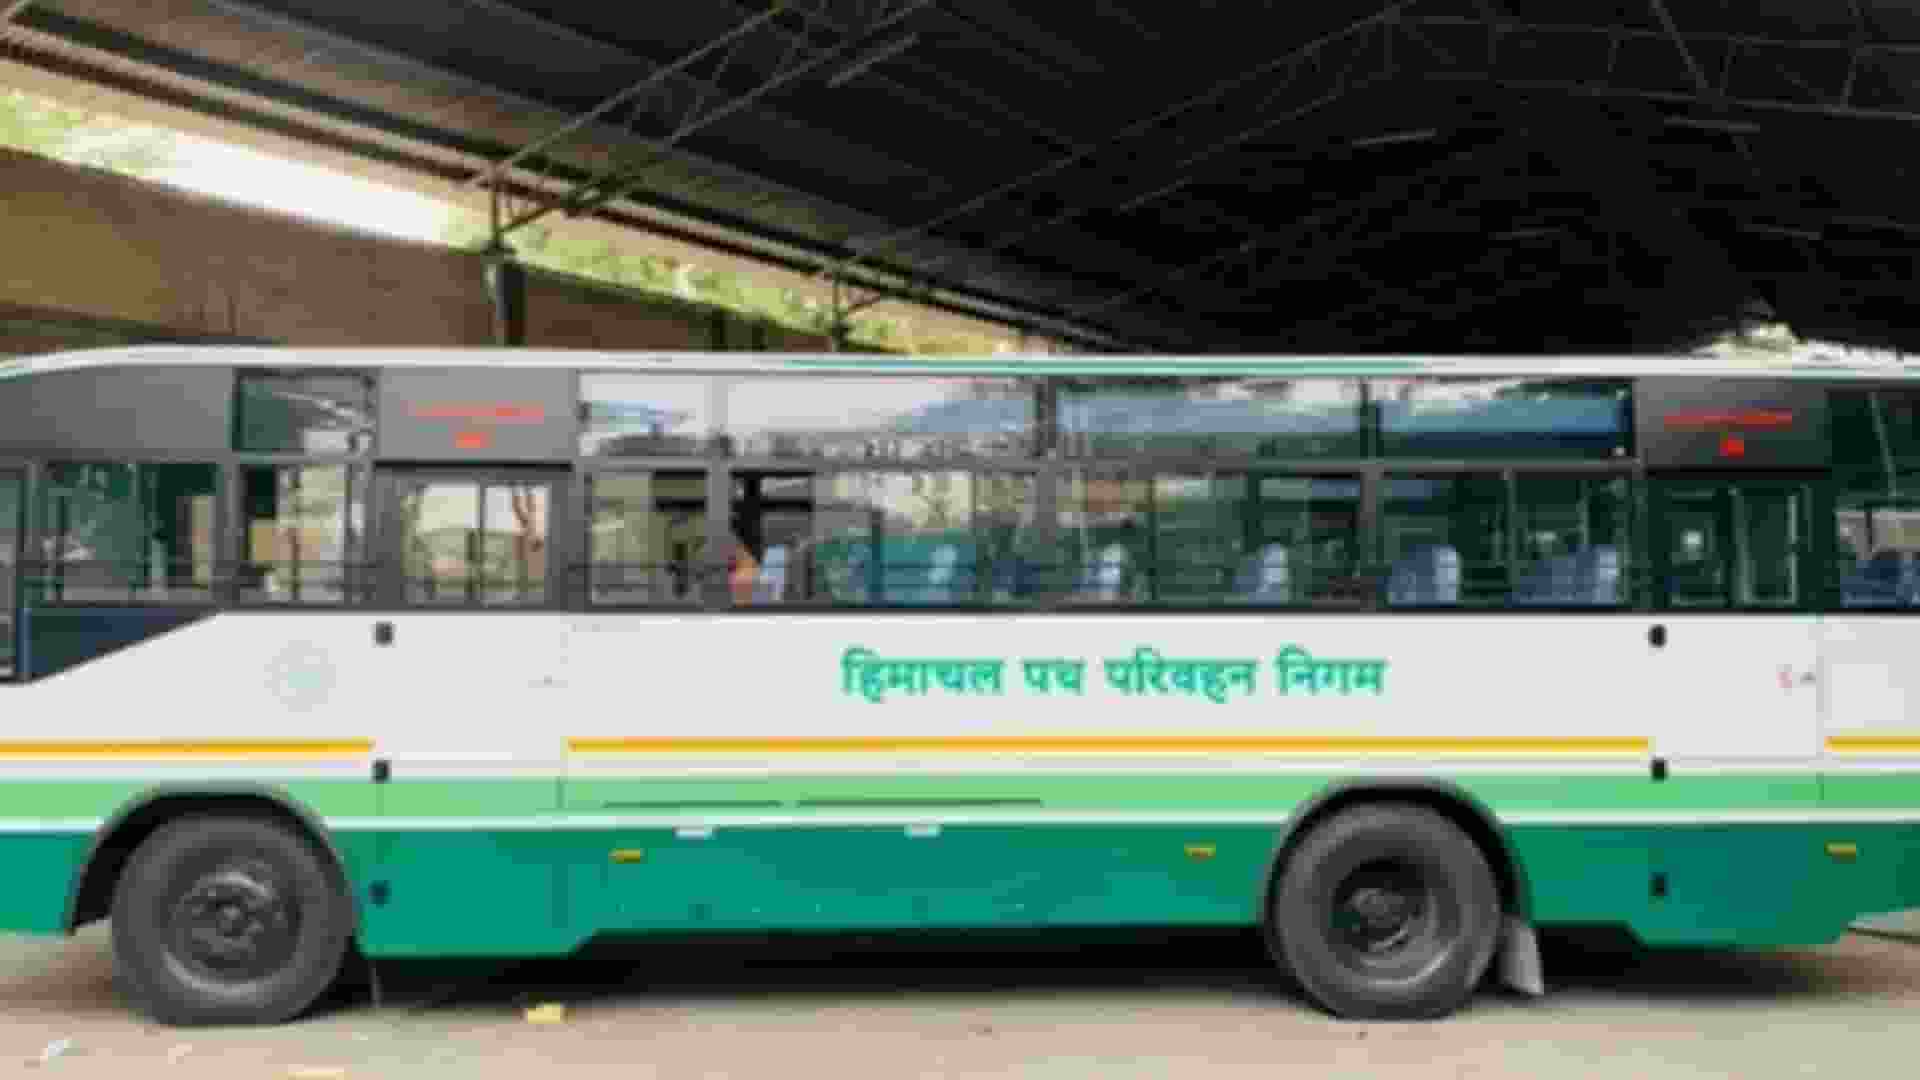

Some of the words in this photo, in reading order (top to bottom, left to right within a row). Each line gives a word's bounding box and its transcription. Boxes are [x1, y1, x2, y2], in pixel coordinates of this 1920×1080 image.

[842, 646, 1005, 702] हिमाचल
[1103, 647, 1259, 702] परिवहन
[1275, 645, 1387, 695] निगम
